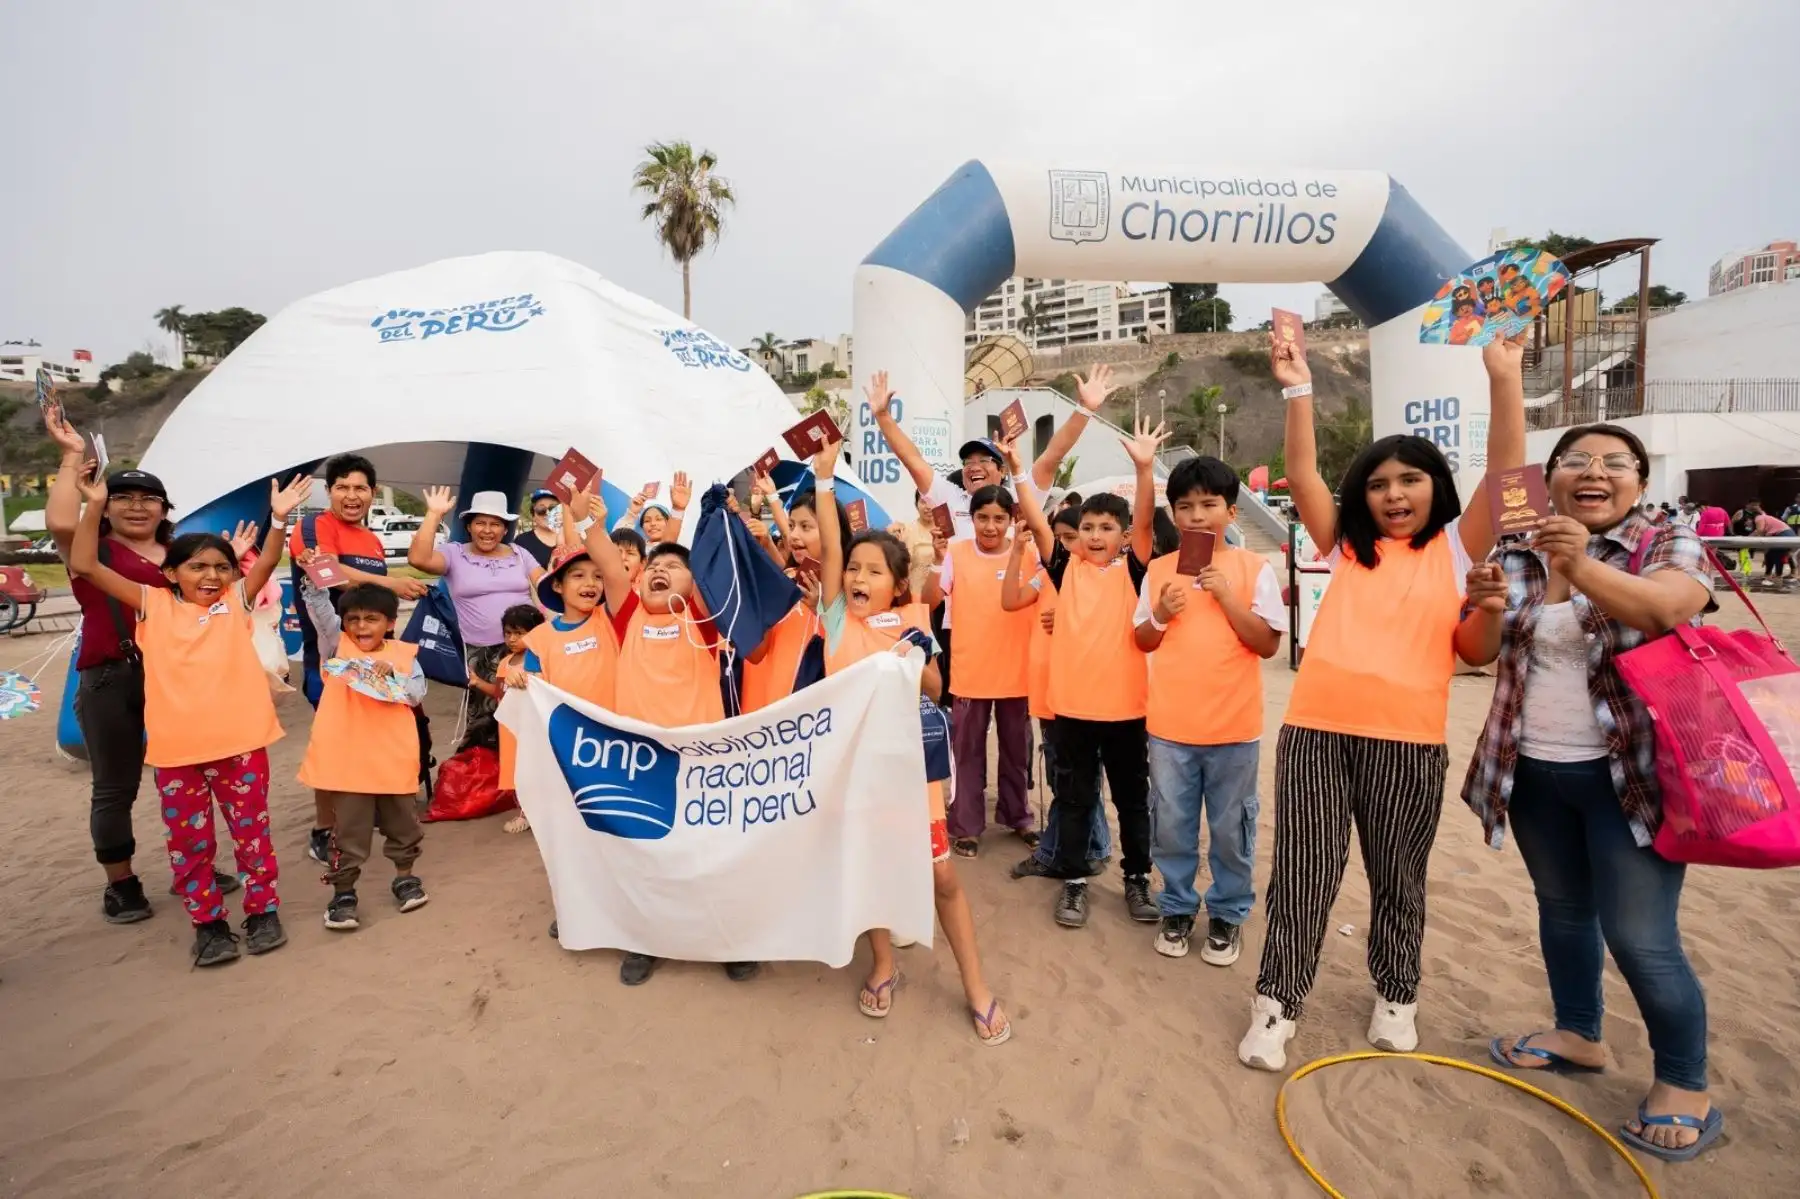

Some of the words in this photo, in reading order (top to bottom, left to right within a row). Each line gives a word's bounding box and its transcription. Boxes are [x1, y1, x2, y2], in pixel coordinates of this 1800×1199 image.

[1121, 175, 1297, 199] Municipalidad
[1305, 180, 1337, 198] de
[1121, 200, 1337, 244] Chorrillos
[379, 328, 413, 341] DEL
[1405, 396, 1460, 425] CHO
[863, 431, 894, 455] RR
[571, 727, 658, 781] bnp
[672, 707, 832, 757] biblioteca
[685, 742, 812, 789] nacional
[684, 790, 732, 827] del
[742, 780, 817, 832] perú
